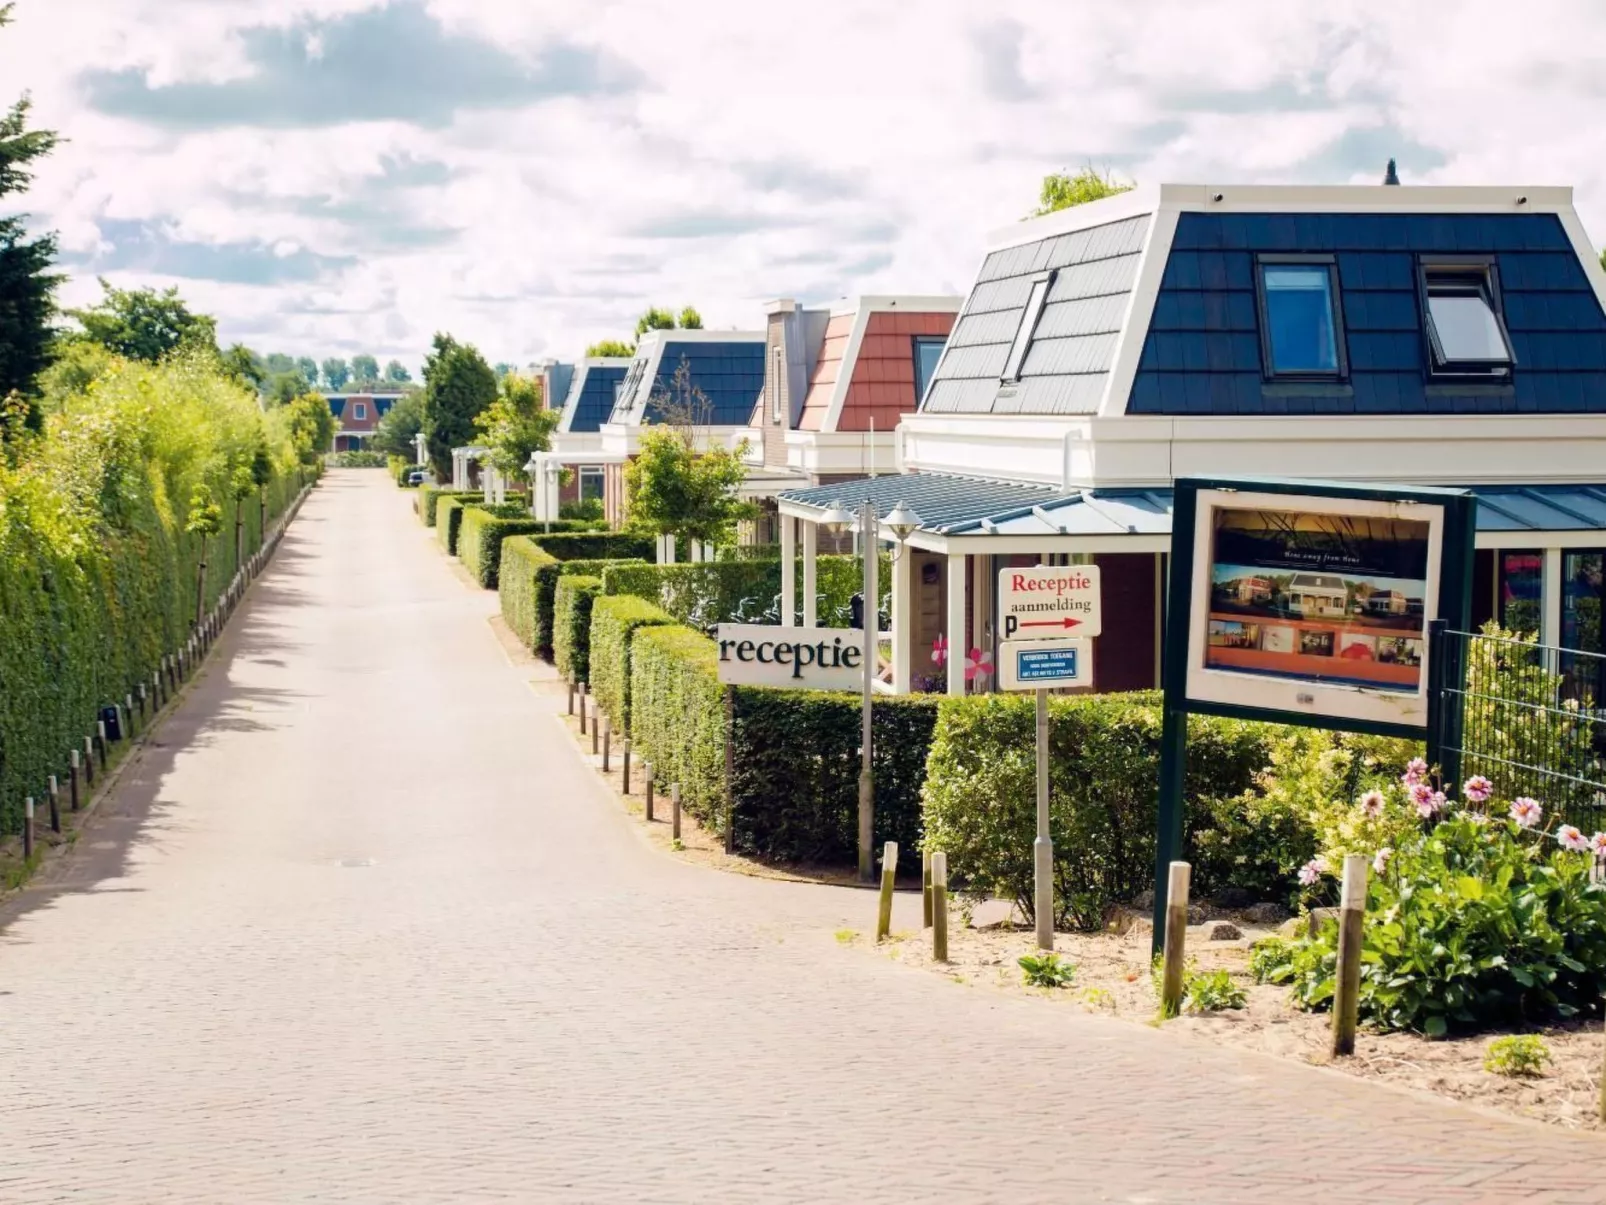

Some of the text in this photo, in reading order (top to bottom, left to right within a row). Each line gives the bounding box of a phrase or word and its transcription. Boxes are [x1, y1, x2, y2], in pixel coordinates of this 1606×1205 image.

[1011, 572, 1091, 596] Receptie
[1011, 598, 1091, 613] aanmelding
[1005, 615, 1018, 638] P
[719, 637, 861, 678] receptie
